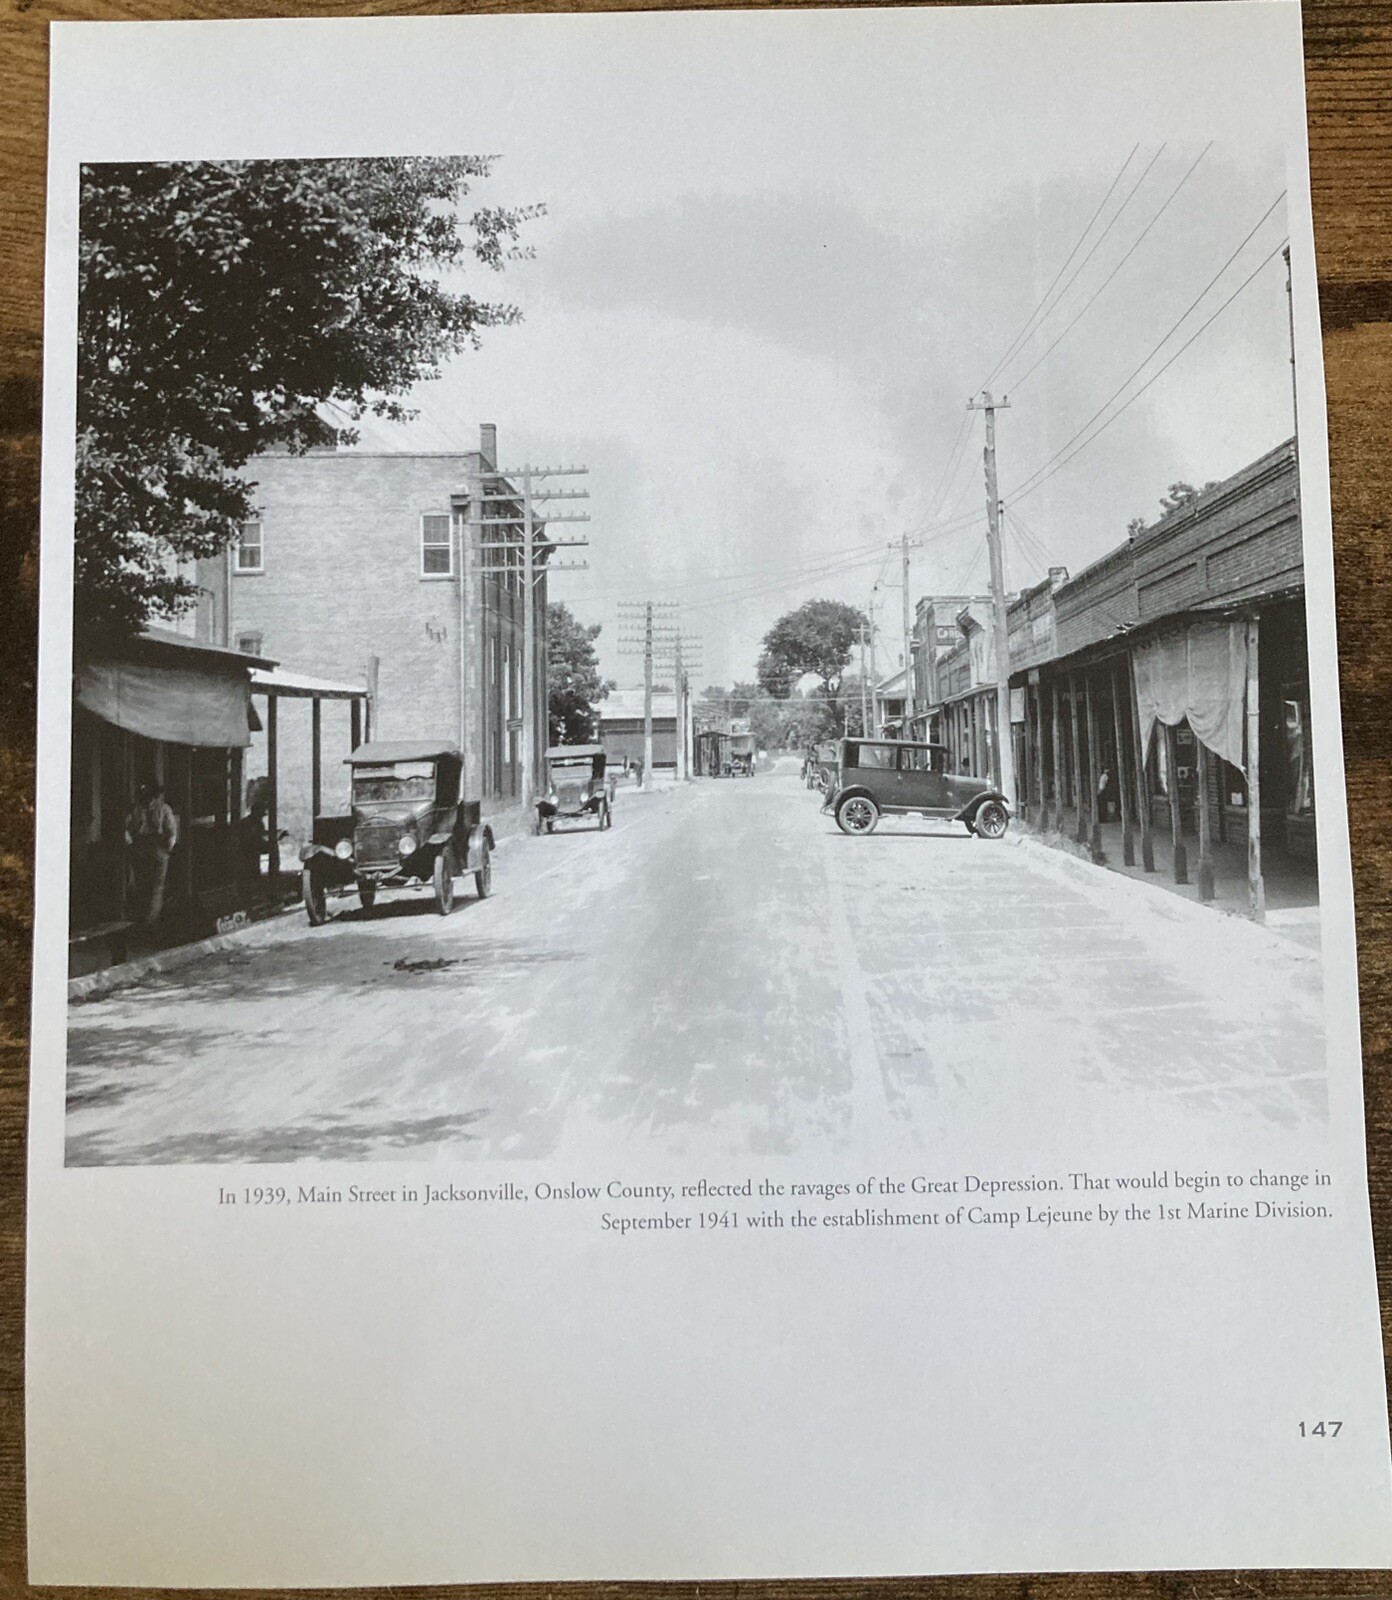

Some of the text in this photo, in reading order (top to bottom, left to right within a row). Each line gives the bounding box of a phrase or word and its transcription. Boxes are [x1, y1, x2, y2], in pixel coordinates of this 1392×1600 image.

[218, 1168, 1332, 1206] In 1939, Main Street in Jacksonville, Onslow County, reflected the ravages of the Great Depression. That would begin to change in
[601, 1200, 1333, 1236] September 1941 with the establishment of Camp Lejeune by the 1st Marine Division.
[1298, 1421, 1343, 1438] 147
